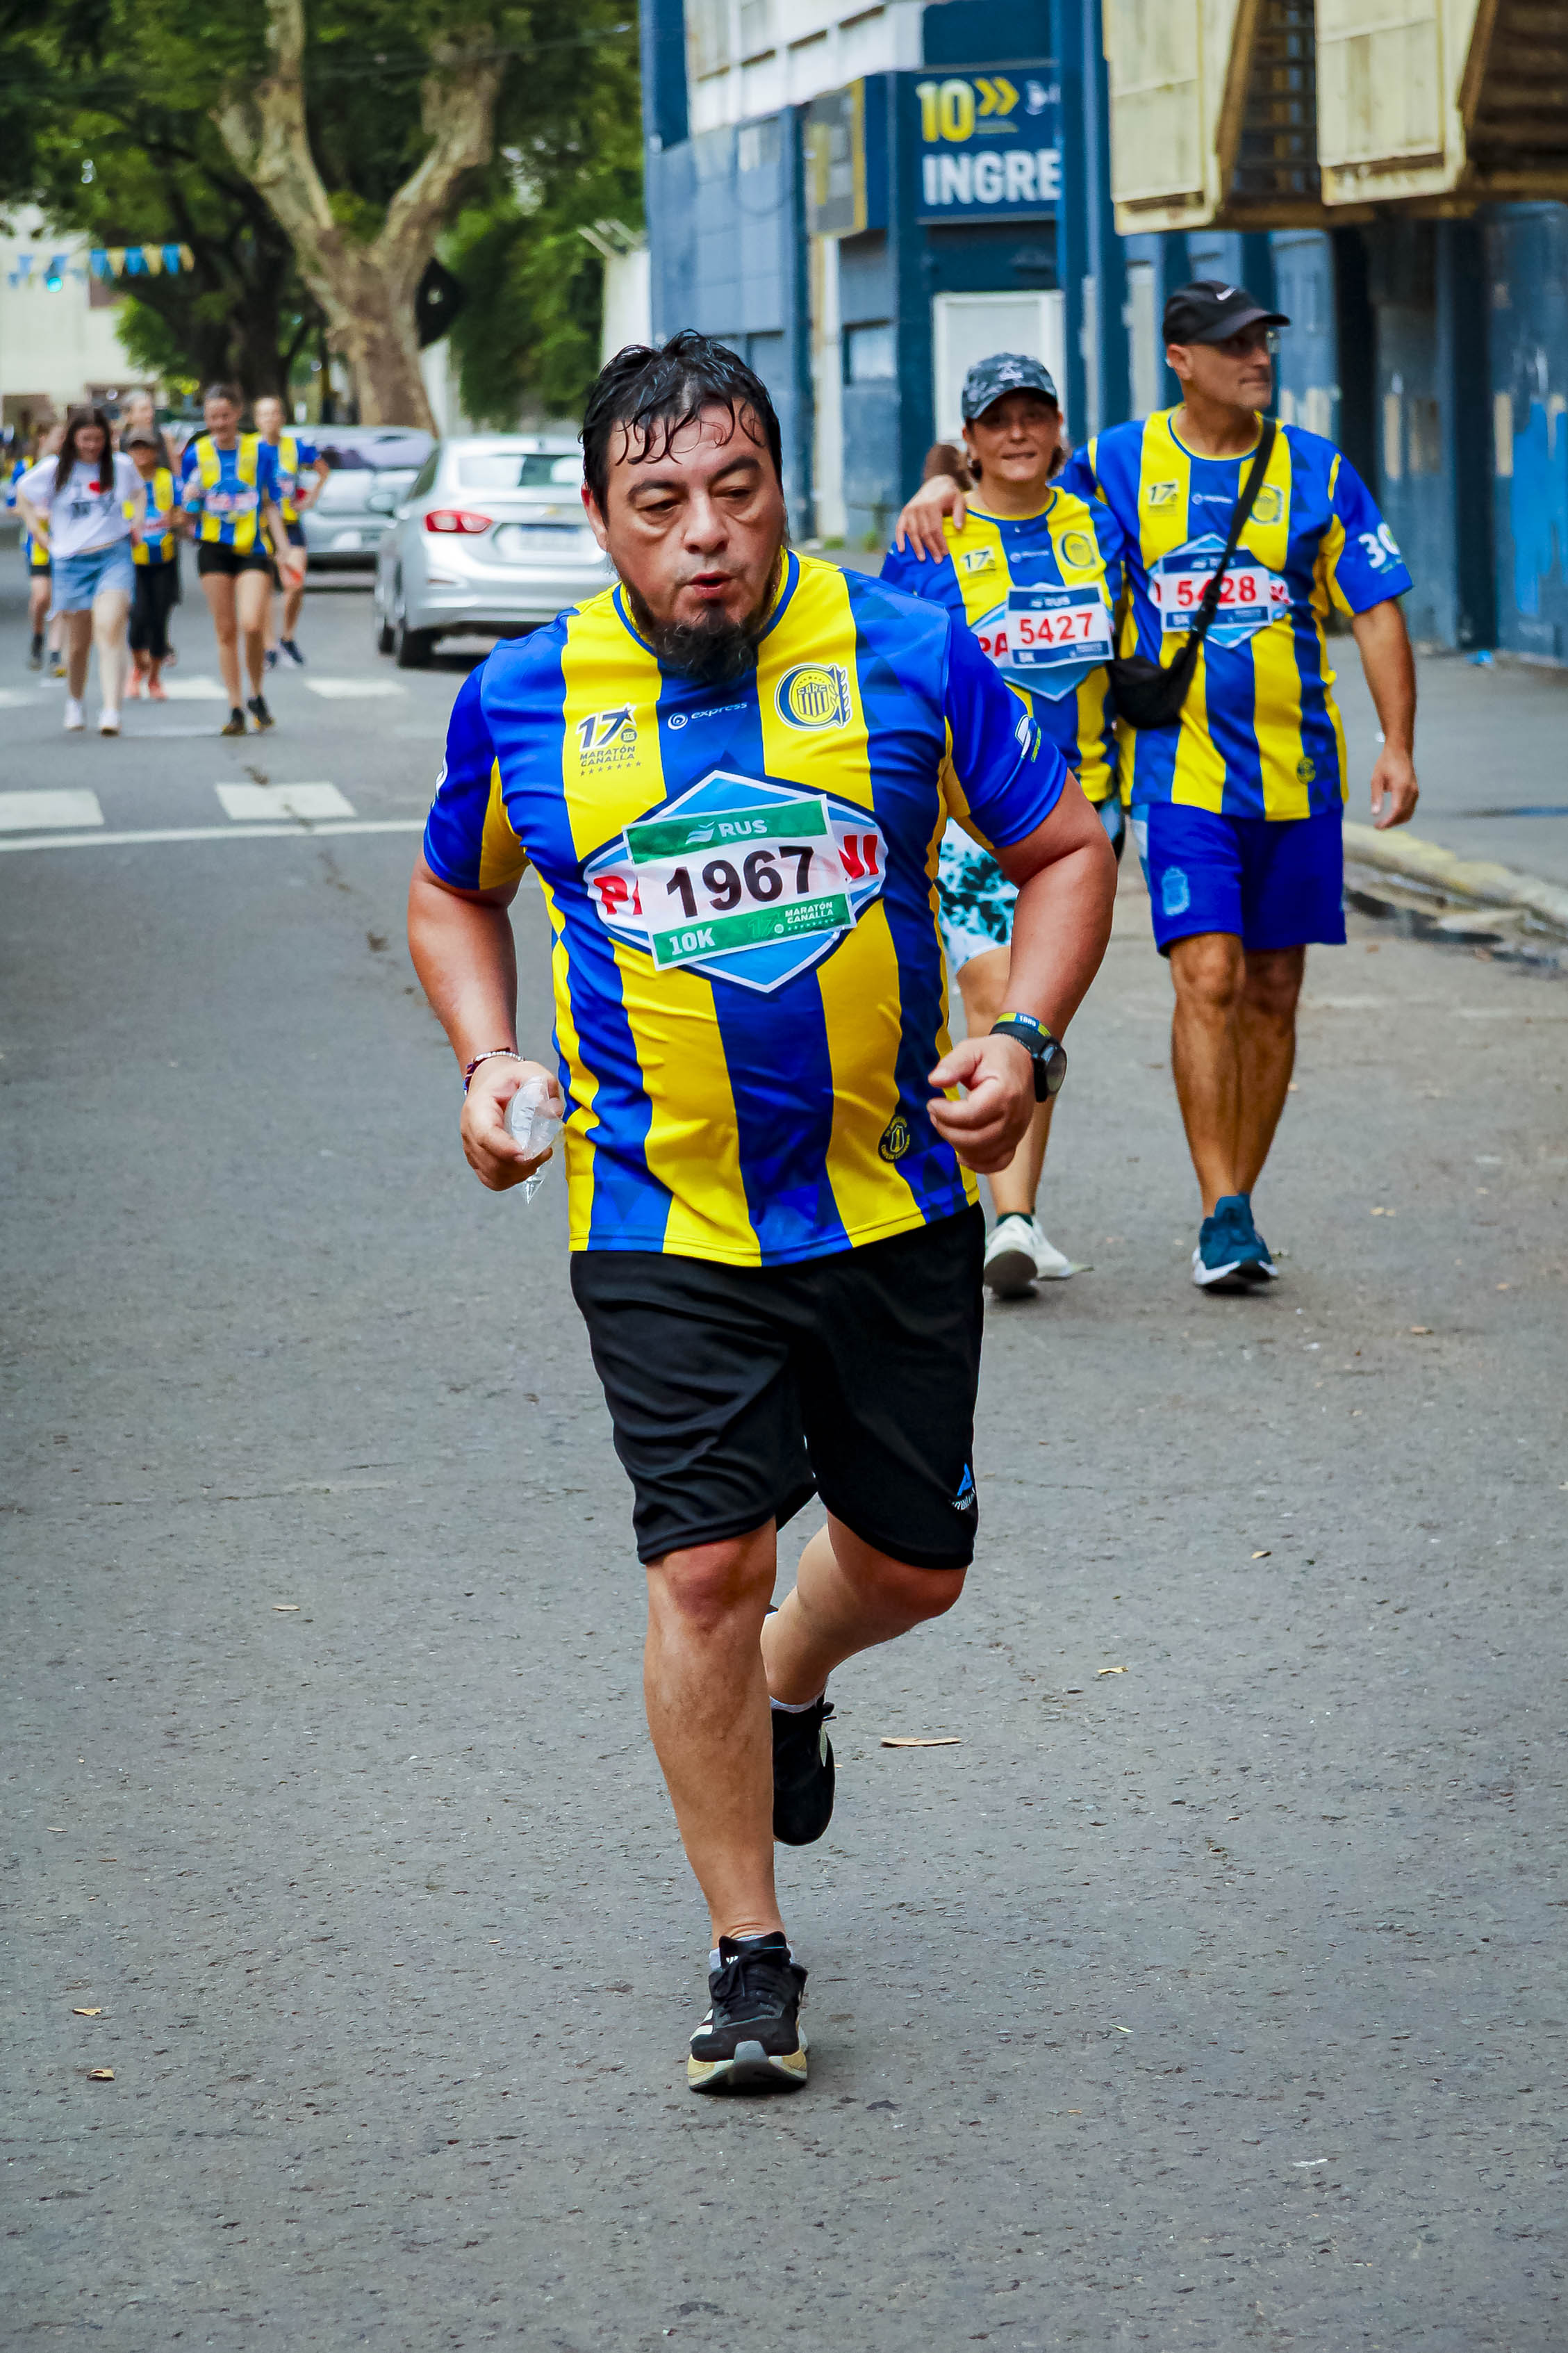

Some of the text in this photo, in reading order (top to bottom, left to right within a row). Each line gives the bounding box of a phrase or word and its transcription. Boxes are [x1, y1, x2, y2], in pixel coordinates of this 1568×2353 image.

[915, 79, 975, 142] 10
[923, 148, 1061, 205] INGRE
[1019, 612, 1093, 644] 5427
[691, 702, 748, 720] express
[576, 707, 634, 752] 17
[579, 744, 636, 760] MARATÓN
[581, 753, 635, 767] CANALLA
[718, 819, 768, 838] RUS
[666, 845, 814, 918] 1967
[785, 901, 833, 918] MARATÓN
[786, 909, 834, 924] CANALLA
[668, 927, 716, 956] 10K
